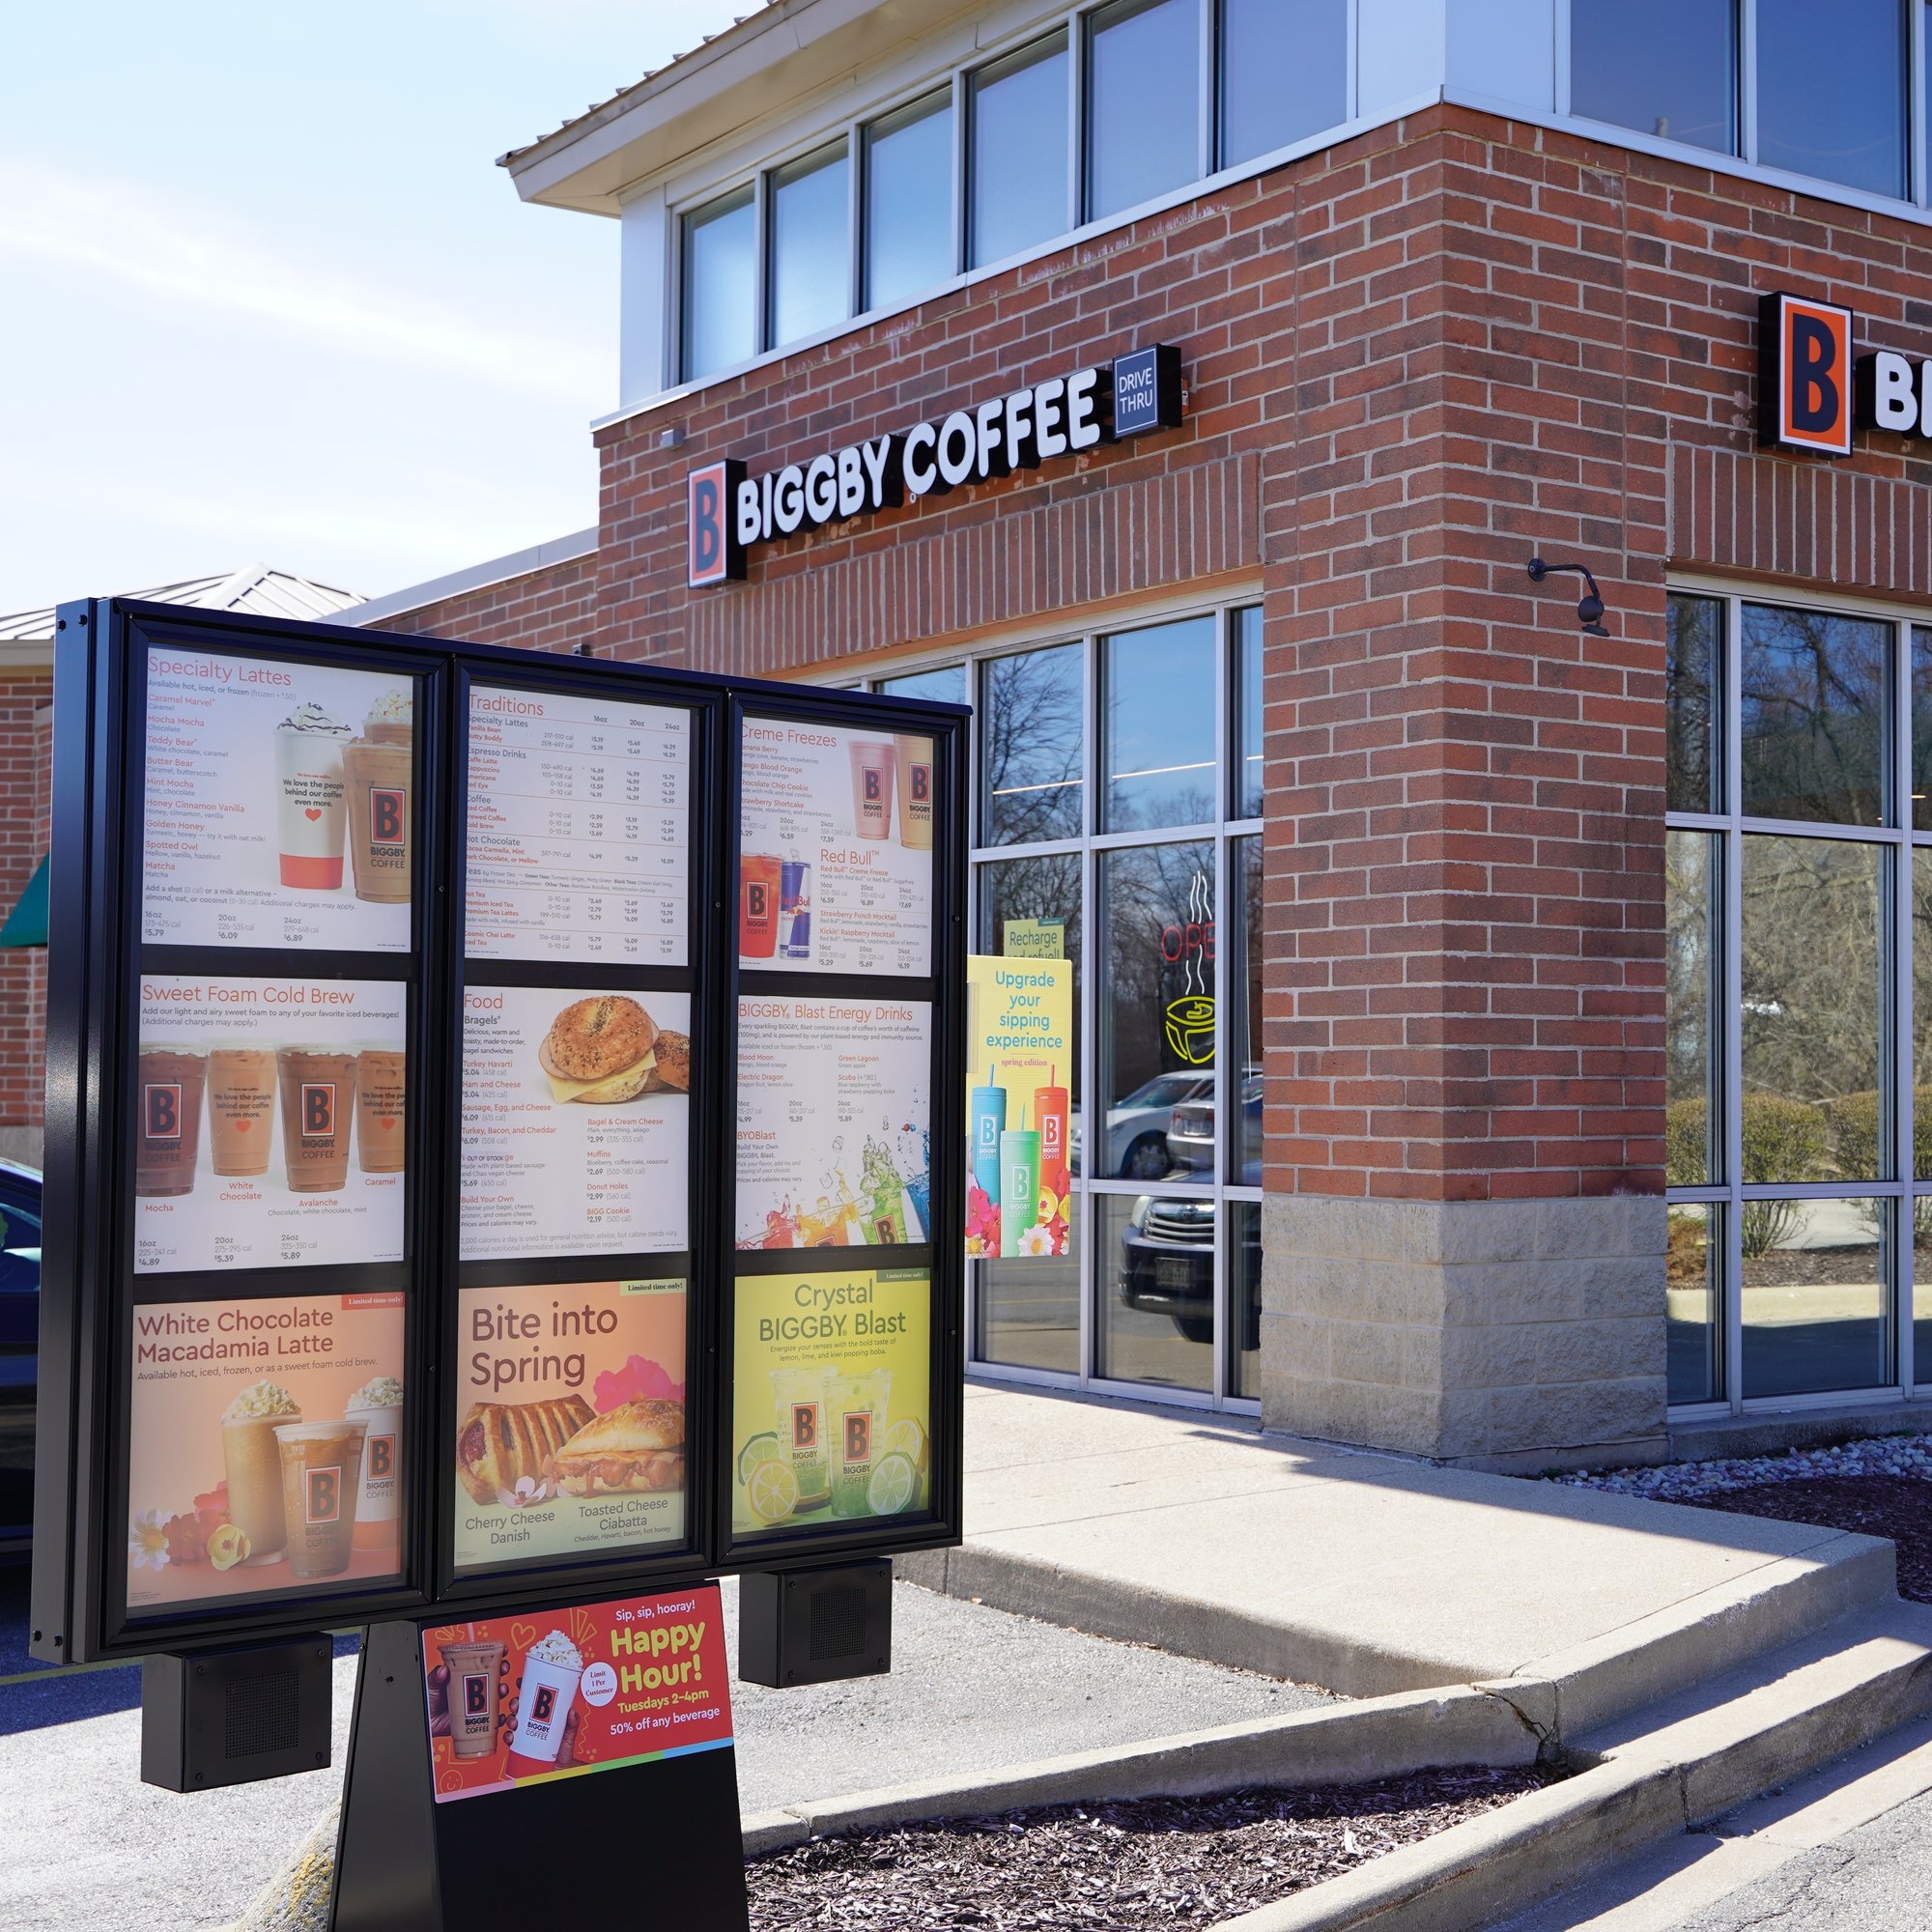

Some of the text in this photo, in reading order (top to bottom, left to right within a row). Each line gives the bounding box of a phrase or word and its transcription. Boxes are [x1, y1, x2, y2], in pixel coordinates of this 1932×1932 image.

[1120, 370, 1152, 392] DRIVE
[1792, 313, 1838, 433] B
[1120, 390, 1152, 414] THRU
[737, 368, 1100, 546] BIGGBY COFFEE
[696, 478, 723, 572] B
[149, 657, 292, 686] Specialty Lattes
[469, 694, 543, 716] Traditions
[504, 716, 528, 727] Lattes
[787, 729, 837, 747] Freezes
[502, 749, 526, 759] Drinks
[283, 779, 292, 787] We
[325, 781, 344, 791] people
[867, 771, 879, 798] B
[913, 767, 926, 798] B
[146, 799, 244, 812] Honey Cinnamon Vanilla
[375, 794, 400, 839] B
[481, 837, 520, 846] Chocolate
[371, 846, 405, 857] BIGGBY
[821, 849, 845, 864] Red
[371, 859, 405, 868] COFFEE
[750, 887, 764, 915] B
[1010, 929, 1057, 948] Recharge
[1161, 923, 1215, 961] OPE
[995, 971, 1055, 988] Upgrade
[142, 985, 355, 1004] Sweet Foam Cold Brew
[464, 993, 503, 1009] Food
[1009, 994, 1040, 1008] your
[174, 1008, 191, 1017] light
[210, 1009, 222, 1018] airy
[362, 1010, 399, 1019] beverages!
[795, 1005, 825, 1019] Blast
[829, 1007, 870, 1022] Energy
[876, 1007, 912, 1021] Drinks
[1000, 1011, 1050, 1030] sipping
[986, 1035, 1063, 1050] experience
[1001, 1059, 1022, 1067] spring
[151, 1090, 174, 1131] B
[308, 1090, 328, 1130] B
[587, 1118, 607, 1126] Bagel
[981, 1118, 995, 1144] B
[1045, 1118, 1058, 1144] B
[301, 1140, 334, 1149] BIGGBY
[738, 1131, 776, 1140] BYOBlast
[301, 1151, 334, 1159] COFFEE
[1013, 1167, 1028, 1199] B
[146, 1204, 174, 1212] Mocha
[298, 1199, 338, 1208] Avalanche
[795, 1278, 872, 1311] Crystal
[138, 1307, 333, 1336] White Chocolate
[472, 1301, 617, 1341] Bite into
[856, 1310, 906, 1335] Blast
[138, 1334, 333, 1364] Macadamia Latte
[137, 1370, 177, 1379] Available
[180, 1368, 197, 1378] hot,
[199, 1368, 221, 1377] iced,
[223, 1366, 253, 1376] frozen,
[284, 1362, 310, 1371] sweet
[335, 1358, 353, 1367] cold
[470, 1346, 584, 1392] Spring
[797, 1408, 813, 1444] B
[848, 1418, 866, 1458] B
[373, 1441, 389, 1475] B
[843, 1464, 870, 1474] BIGGBY
[366, 1480, 394, 1490] BIGGBY
[312, 1474, 333, 1518] B
[579, 1498, 668, 1517] Toasted Cheese
[466, 1511, 554, 1531] Cherry Cheese
[600, 1516, 647, 1530] Ciabatta
[491, 1530, 529, 1545] Danish
[574, 1534, 599, 1543] Cheddar,
[601, 1531, 622, 1540] Havarti,
[624, 1529, 641, 1538] bacon,
[655, 1525, 670, 1534] honey
[615, 1600, 696, 1622] Sip, sip, hooray!
[611, 1622, 706, 1657] Happy
[620, 1654, 702, 1692] Hour!
[469, 1679, 485, 1712] B
[585, 1687, 612, 1696] Customer
[535, 1690, 552, 1719] B
[618, 1697, 668, 1714] Tuesdays
[465, 1717, 490, 1725] BIGGBY
[466, 1725, 490, 1734] COFFEE
[527, 1722, 551, 1732] BIGGBY
[611, 1707, 721, 1735] 50% off any beverage
[526, 1730, 548, 1740] COFFEE
